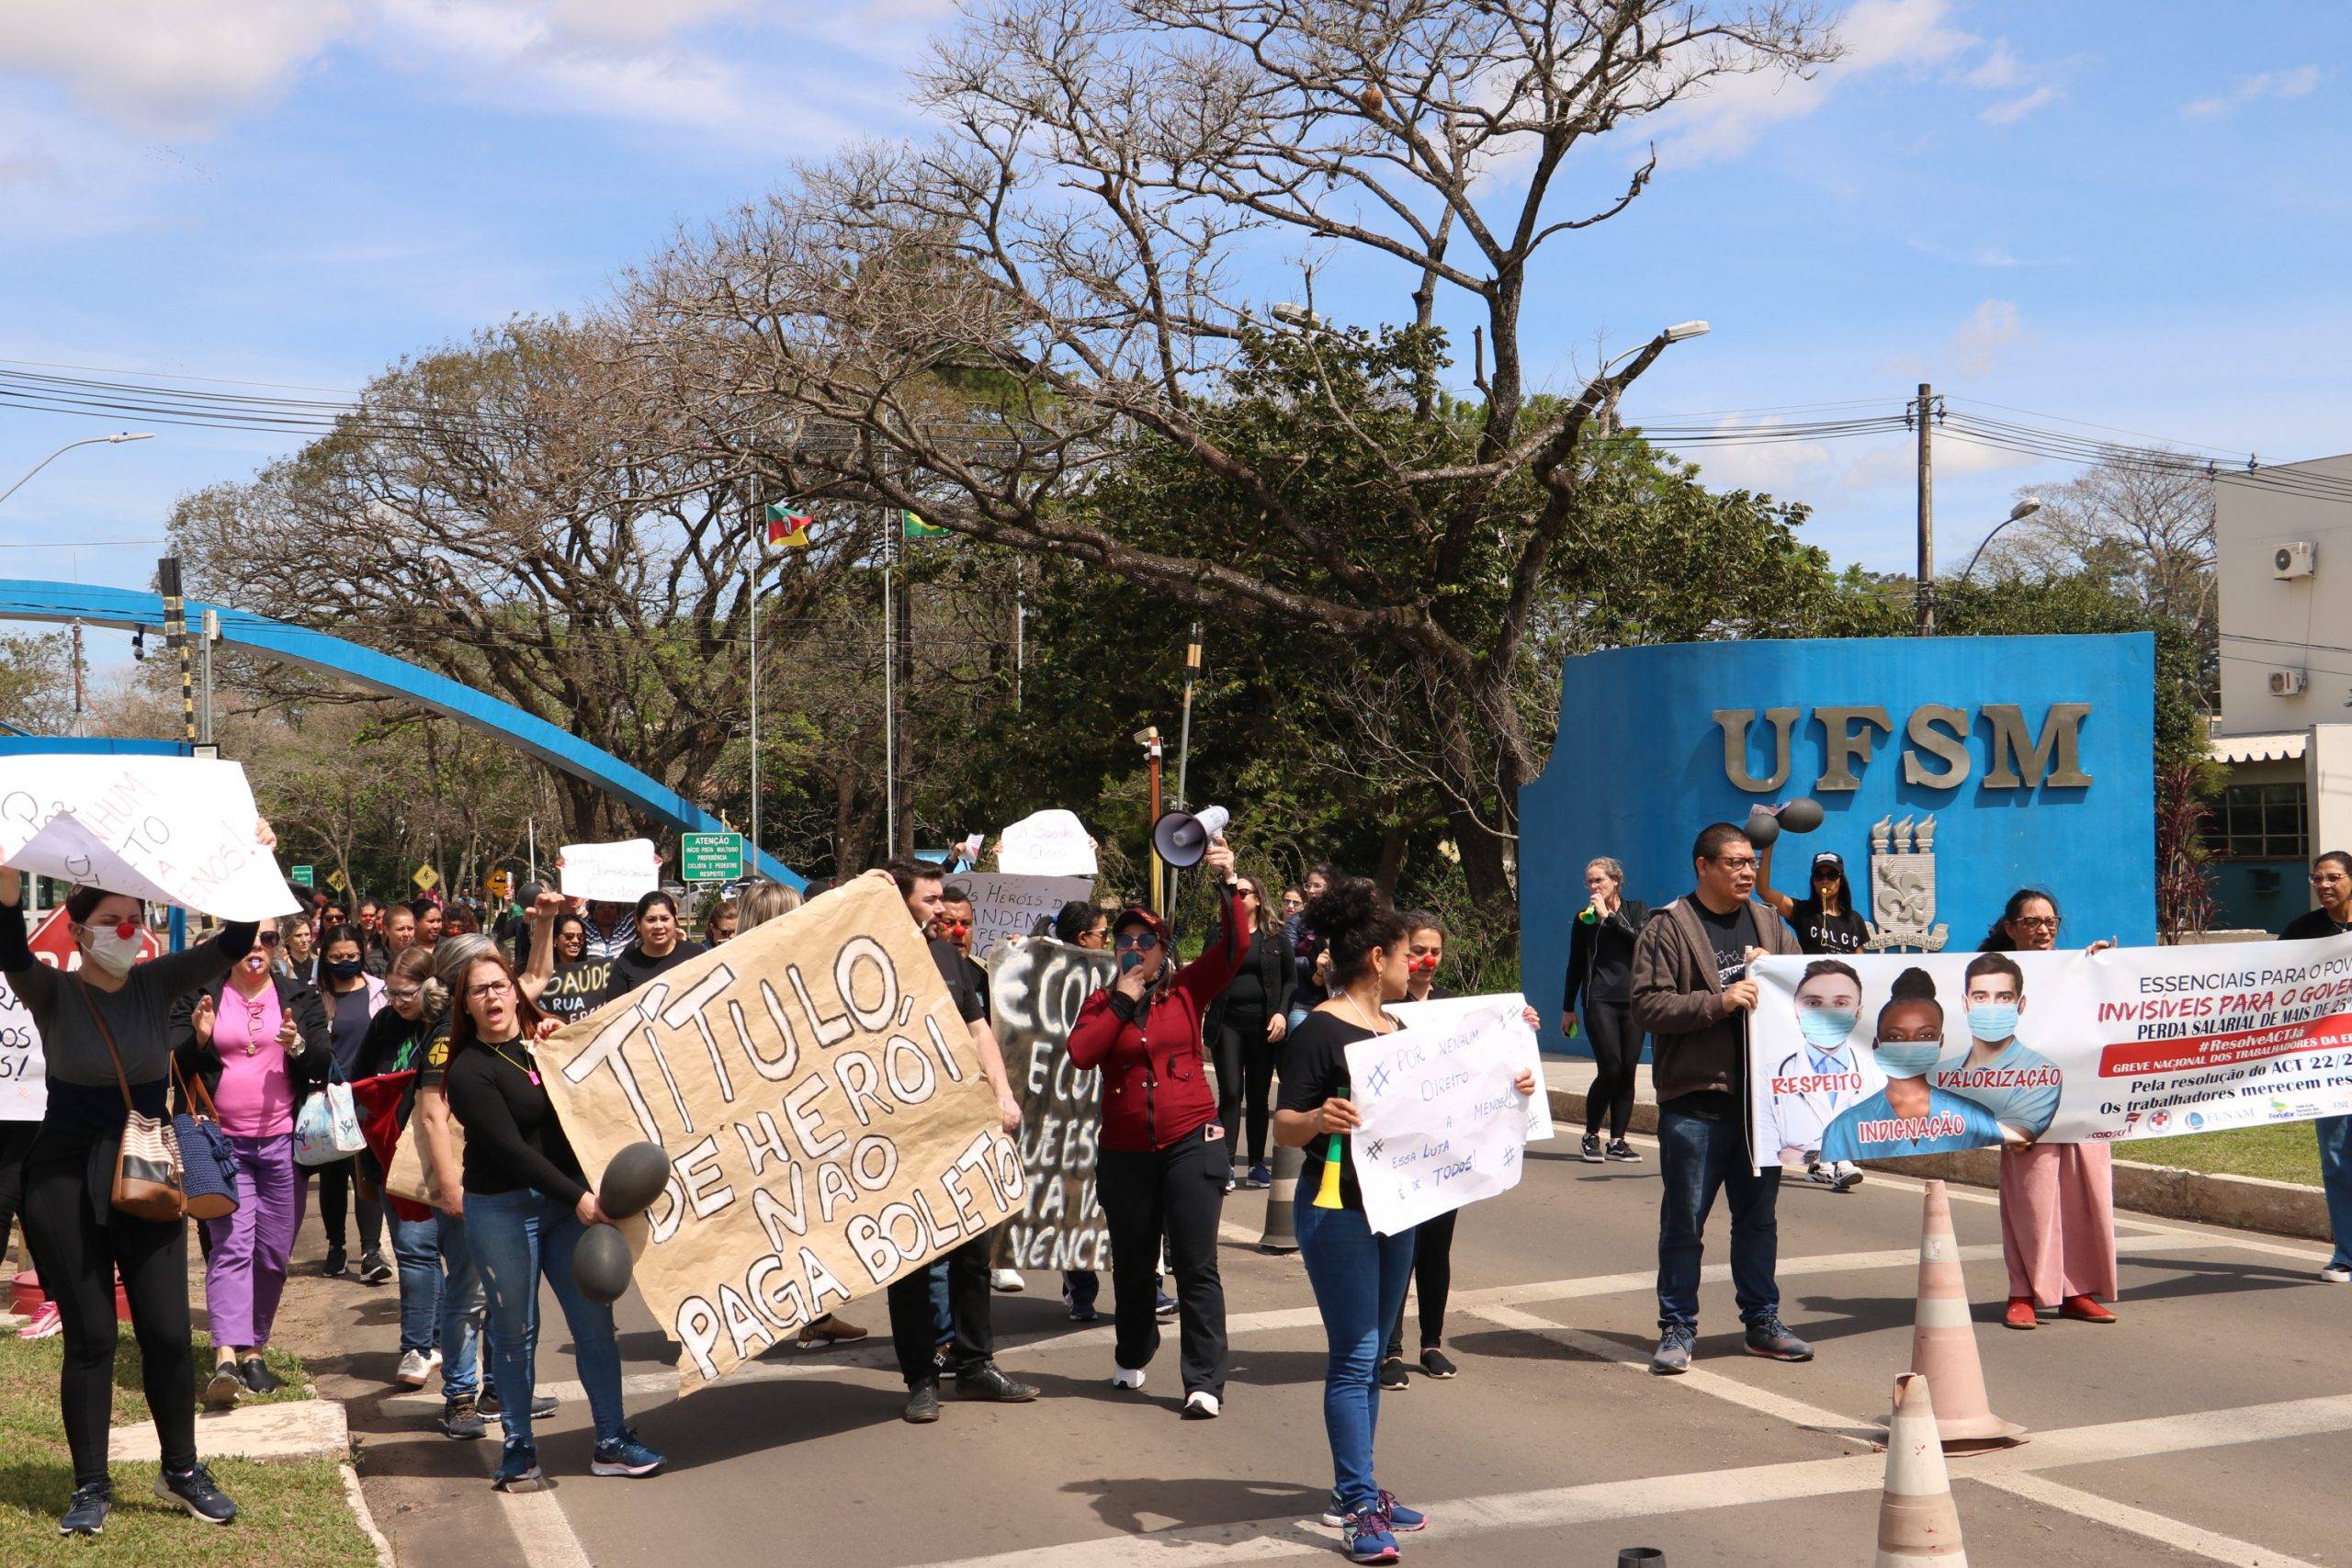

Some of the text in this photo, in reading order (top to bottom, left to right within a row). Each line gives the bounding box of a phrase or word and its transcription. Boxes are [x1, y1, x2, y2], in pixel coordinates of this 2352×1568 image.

[1712, 703, 2093, 792] UFSM
[695, 836, 729, 846] ATENÇÃO
[987, 884, 1043, 907] HERÓIS
[542, 961, 612, 995] SAÚDE
[2141, 970, 2256, 993] ESSENCIAIS
[2261, 967, 2306, 986] PARA
[2309, 964, 2321, 979] O
[552, 996, 584, 1011] RUA
[2098, 993, 2213, 1023] INVISÍVEIS
[2219, 990, 2274, 1016] PARA
[2280, 988, 2296, 1007] O
[2138, 1021, 2187, 1041] PERDA
[2191, 1014, 2255, 1037] SALARIAL
[2260, 1011, 2278, 1028] DE
[2282, 1005, 2312, 1024] MAIS
[2312, 1001, 2330, 1018] DE
[1396, 1045, 1426, 1072] POR
[1438, 1030, 1481, 1056] NENHUM
[2112, 1062, 2151, 1074] GREVE
[2153, 1056, 2207, 1071] NACIONAL
[2210, 1052, 2233, 1064] DOS
[2235, 1037, 2318, 1059] TRABALHADORES
[2320, 1034, 2338, 1046] DA
[2199, 1025, 2305, 1053] #ResolveACTJá
[1420, 1071, 1469, 1101] DIREITO
[1771, 1064, 2063, 1095] RESPEITO VALORIZAÇÃO
[2131, 1080, 2165, 1093] Pela
[2170, 1067, 2244, 1090] resolução
[2248, 1065, 2267, 1077] do
[2271, 1058, 2303, 1074] ACT
[2100, 1102, 2121, 1115] Os
[2127, 1087, 2235, 1112] trabalhadores
[2241, 1078, 2321, 1098] merecem
[1446, 1116, 1453, 1129] A
[1859, 1112, 1966, 1143] INDIGNAÇÃO
[2207, 1109, 2256, 1122] FENAM
[1392, 1152, 1417, 1169] ESSA
[1423, 1139, 1450, 1158] LUTA
[1410, 1179, 1421, 1191] DE
[1432, 1148, 1478, 1187] TODOS!
[646, 1136, 735, 1244] DE
[674, 1131, 1028, 1381] PAGA BOLETO
